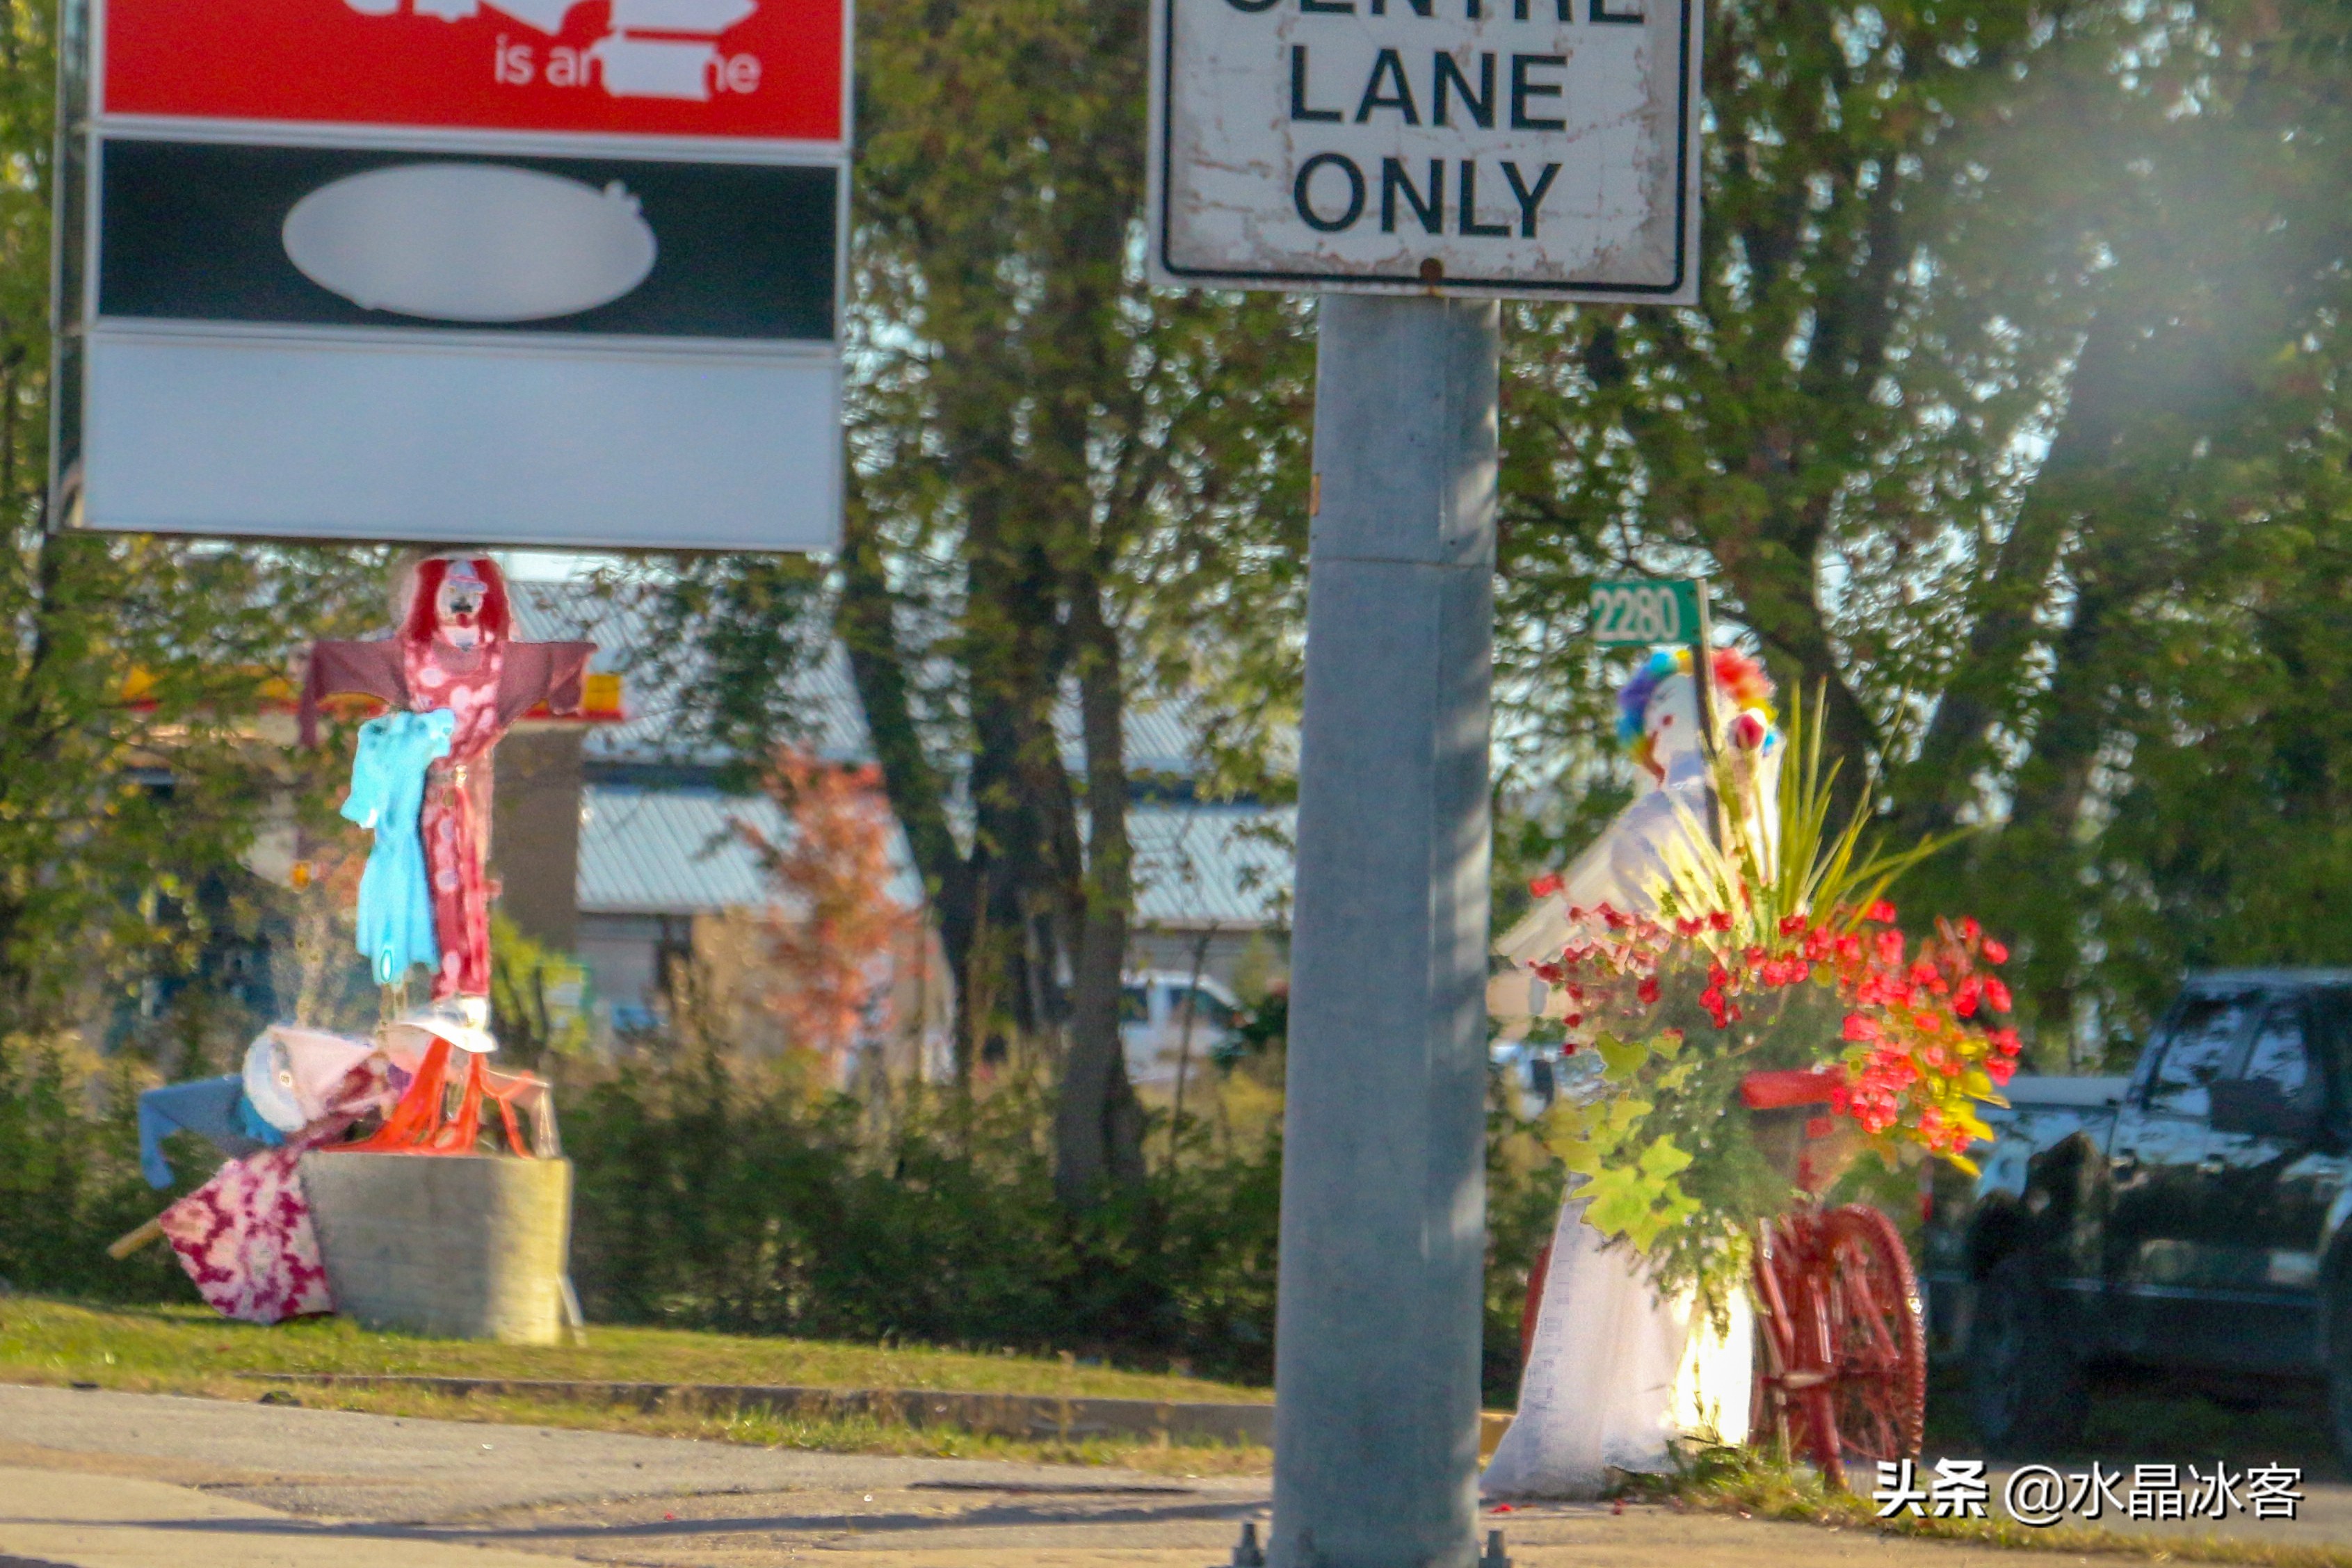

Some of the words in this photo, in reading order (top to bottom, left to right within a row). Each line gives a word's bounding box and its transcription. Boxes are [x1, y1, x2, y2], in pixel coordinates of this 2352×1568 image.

[494, 33, 534, 86] is
[1291, 45, 1568, 131] LANE
[1294, 152, 1563, 239] ONLY
[1592, 587, 1680, 640] 2280
